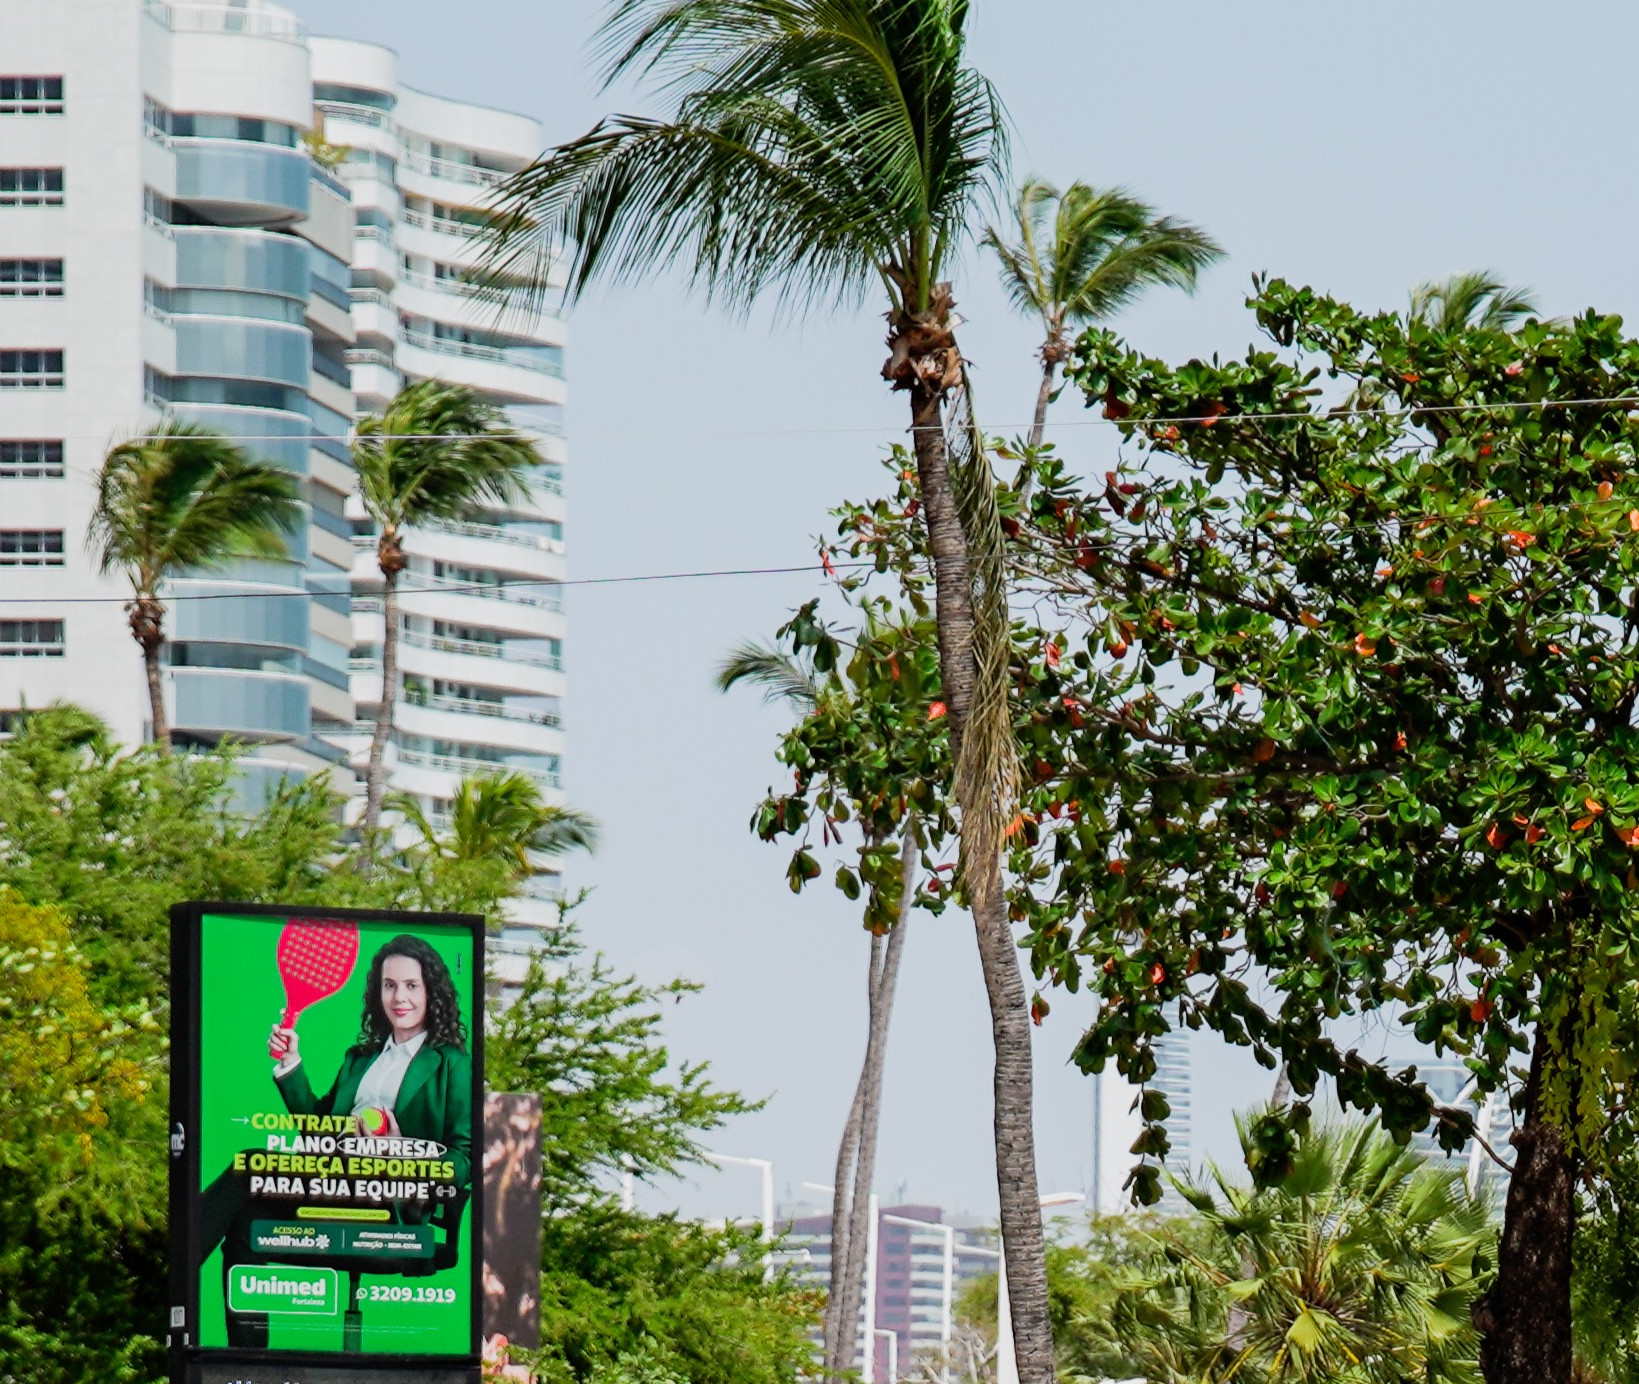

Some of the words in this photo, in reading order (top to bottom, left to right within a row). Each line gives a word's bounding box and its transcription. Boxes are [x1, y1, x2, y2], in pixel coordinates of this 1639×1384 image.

[251, 1113, 356, 1133] CONTRATE
[267, 1135, 336, 1154] PLANO
[343, 1137, 441, 1158] EMPRESA
[233, 1154, 246, 1171] E
[250, 1154, 344, 1178] OFEREÇA
[348, 1158, 455, 1179] ESPORTES
[250, 1176, 305, 1195] PARA
[309, 1178, 351, 1197] SUA
[257, 1235, 315, 1247] wellhub
[240, 1275, 326, 1297] Unimed
[370, 1285, 456, 1303] 3209.1919
